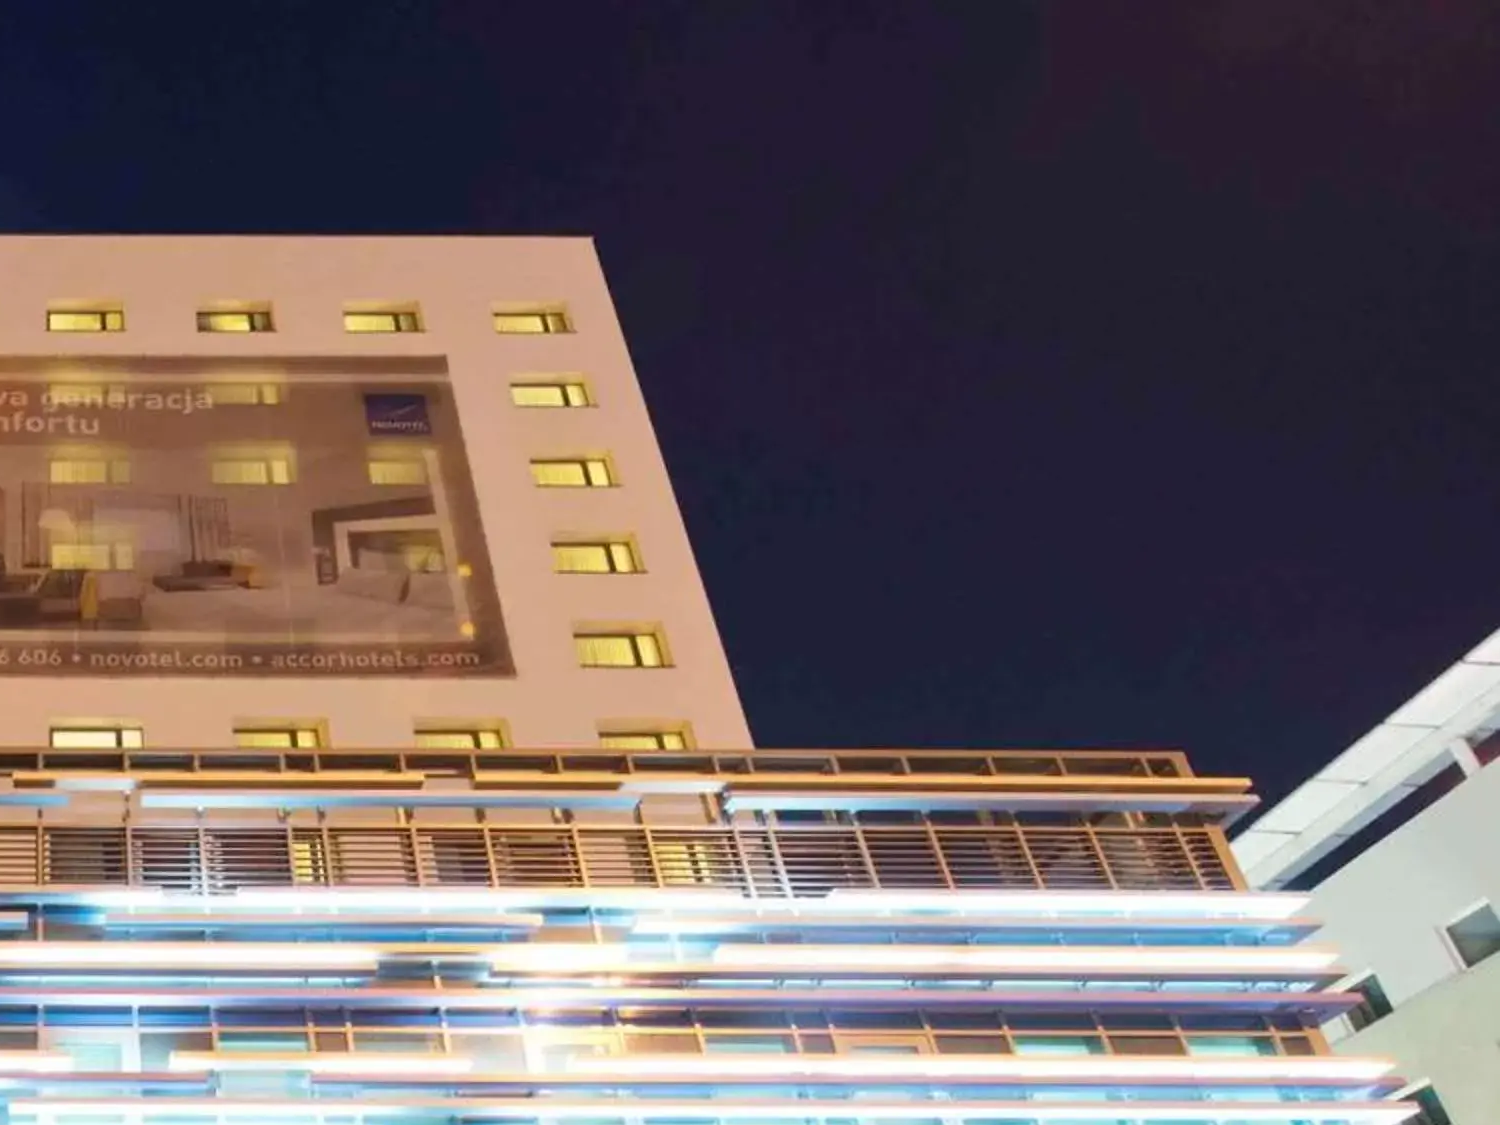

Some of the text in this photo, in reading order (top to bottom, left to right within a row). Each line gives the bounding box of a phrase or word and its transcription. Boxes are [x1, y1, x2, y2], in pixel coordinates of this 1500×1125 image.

[41, 388, 213, 415] generacja
[17, 648, 62, 666] 606
[90, 648, 243, 668] novotel.com
[271, 650, 480, 669] accorhotels.com
